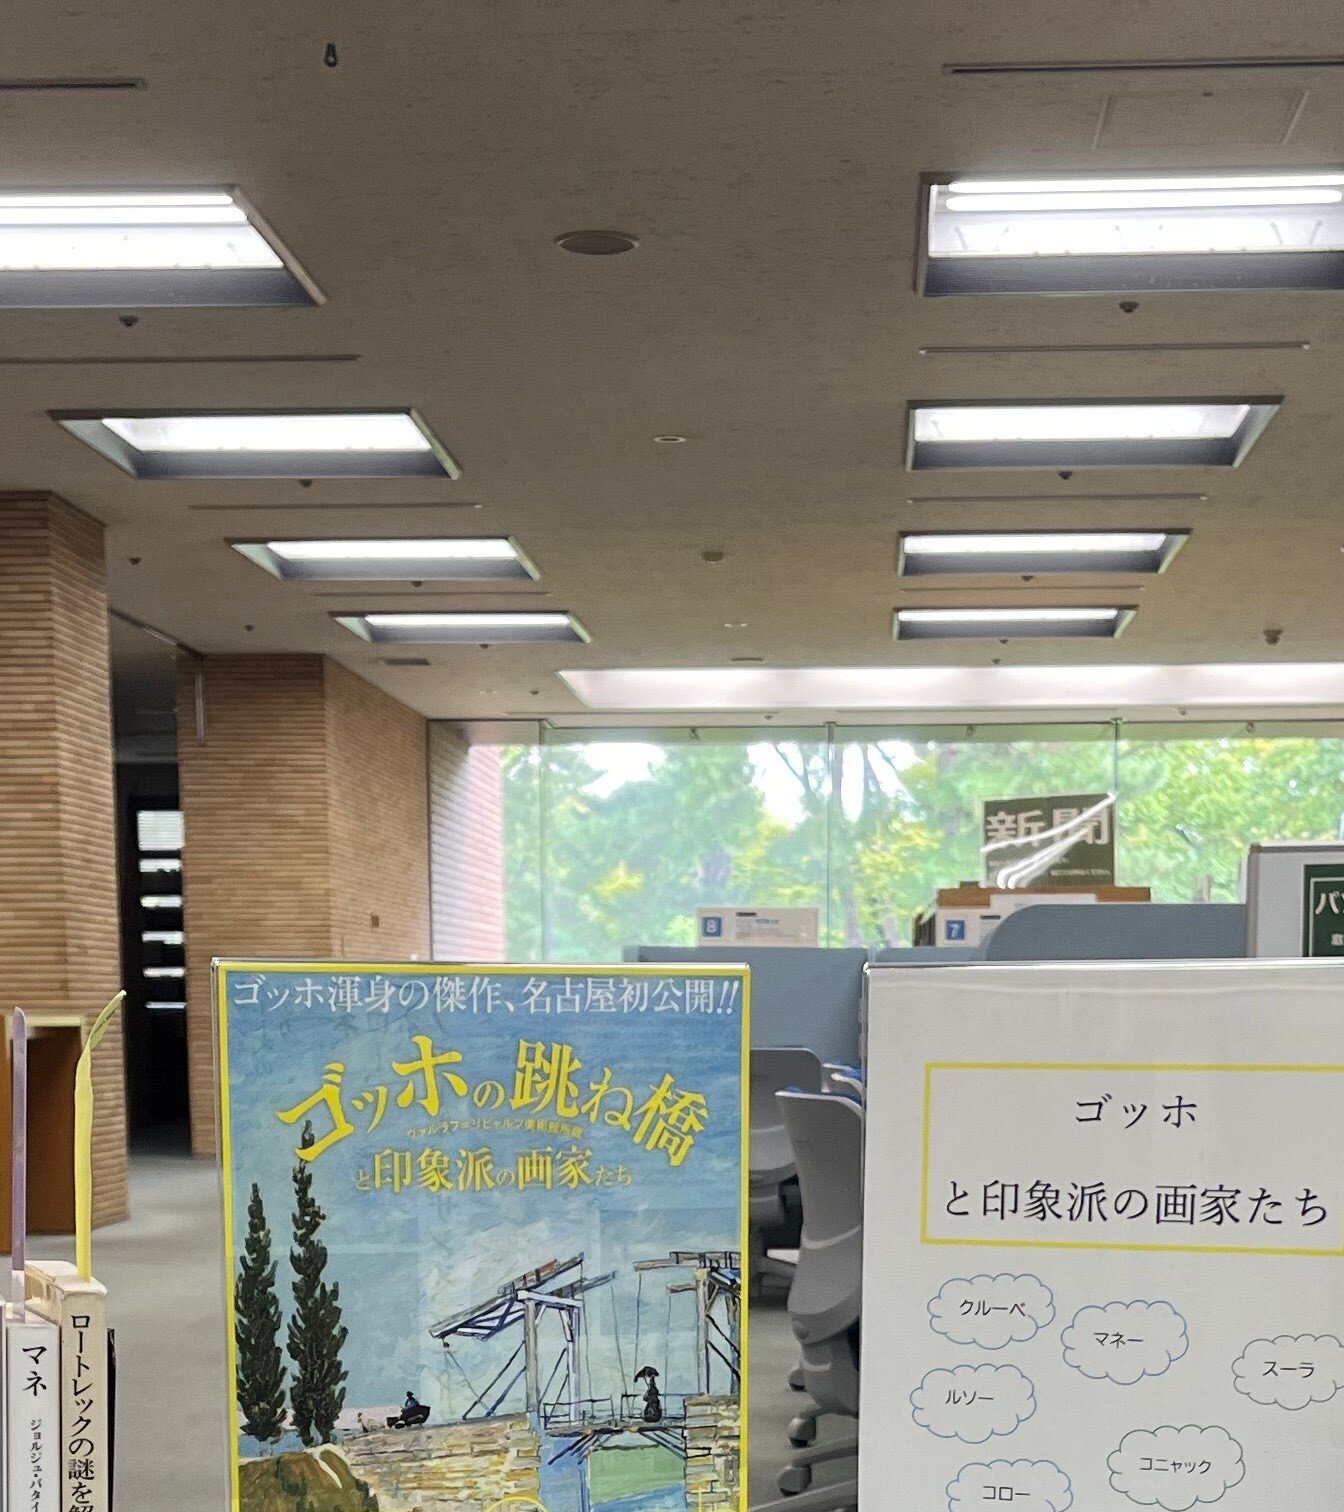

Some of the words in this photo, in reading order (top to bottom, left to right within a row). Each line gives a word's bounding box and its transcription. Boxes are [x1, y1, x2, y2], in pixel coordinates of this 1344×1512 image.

[276, 1035, 711, 1167] ゴッホの跳ね橋
[1074, 1092, 1199, 1130] ゴッホ
[356, 1145, 634, 1193] と印象派の画家たち
[944, 1178, 1330, 1227] と印象派の画家たち
[958, 1298, 1027, 1317] クルーベ
[1093, 1331, 1145, 1349] マネー
[22, 1345, 48, 1397] マネ
[1262, 1360, 1316, 1379] スーラ
[945, 1389, 995, 1407] ルソー
[1138, 1456, 1213, 1476] コニャック
[981, 1485, 1032, 1502] コロー
